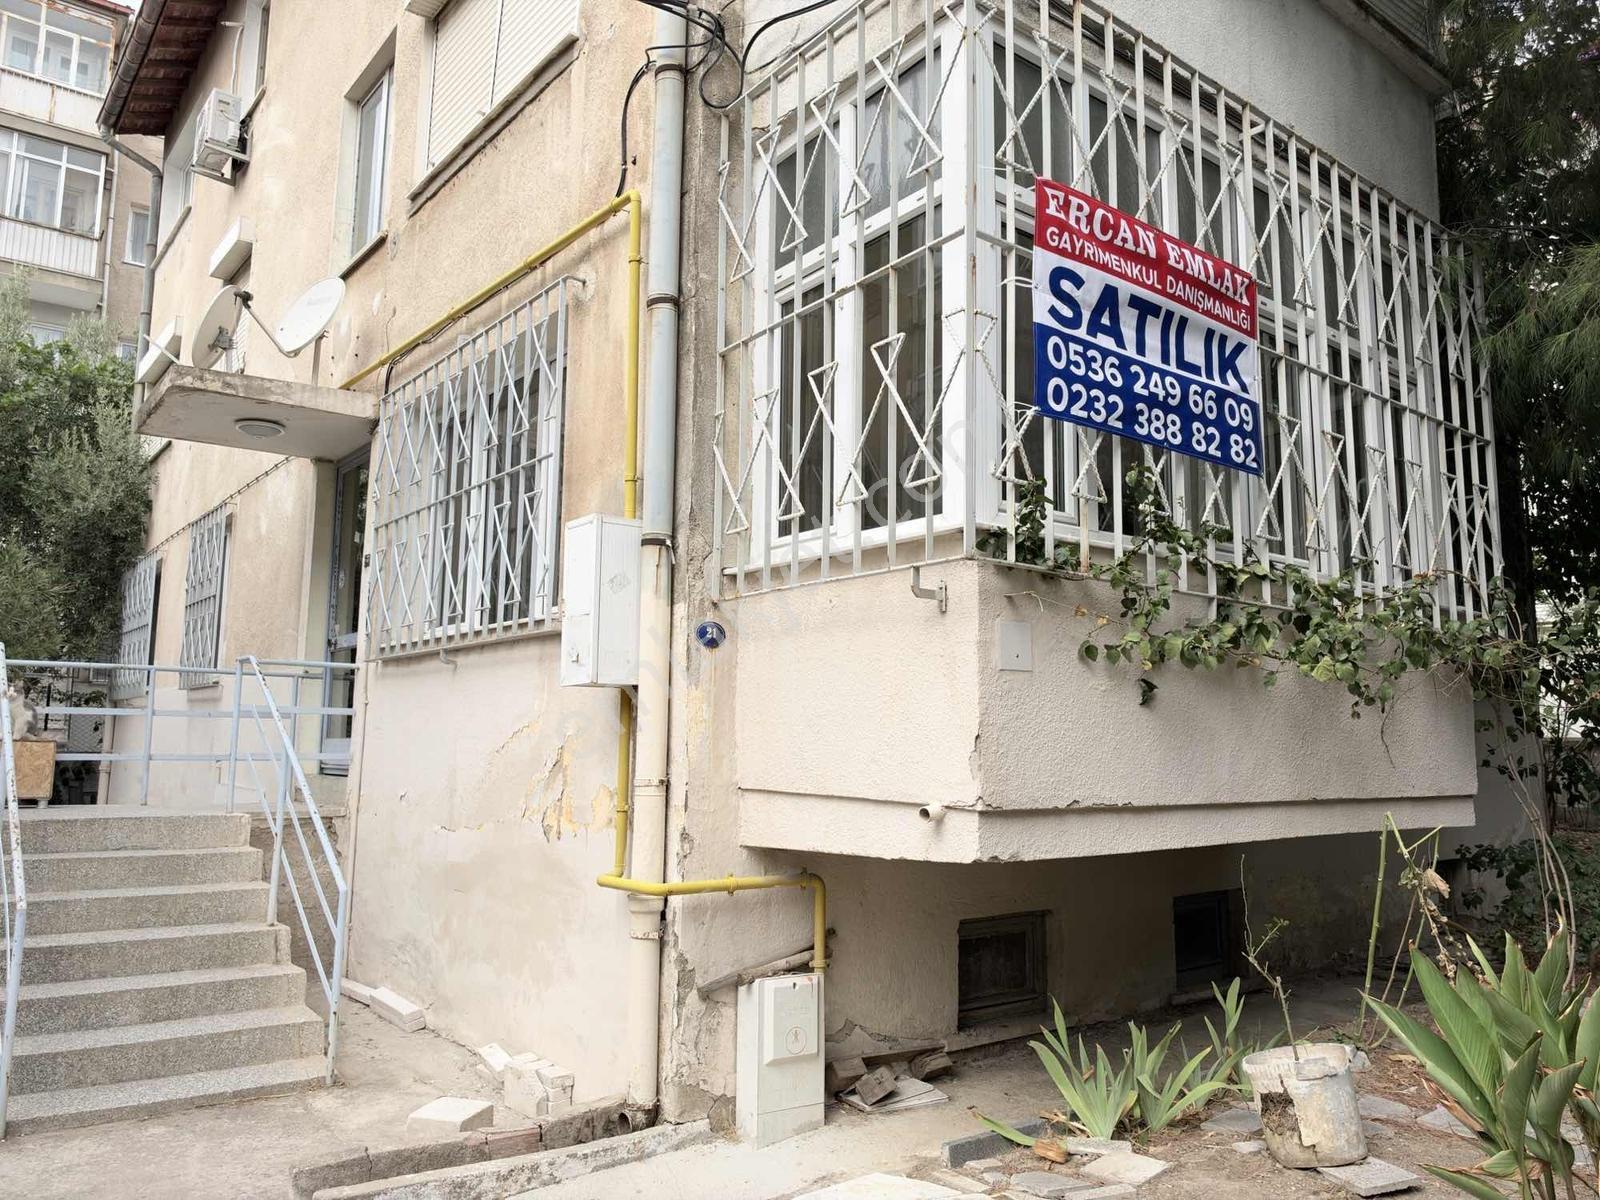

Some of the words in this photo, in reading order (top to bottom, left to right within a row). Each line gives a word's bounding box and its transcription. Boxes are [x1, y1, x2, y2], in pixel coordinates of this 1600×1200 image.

[1045, 186, 1157, 259] ERCAN
[1163, 239, 1251, 307] EMLAK
[1046, 226, 1162, 290] GAYRİMENKUL
[1166, 275, 1251, 332] DANIŞMANLIĞI
[1047, 265, 1251, 397] SATILIK
[1047, 335, 1123, 388] 0536
[1130, 364, 1182, 407] 249
[1188, 384, 1218, 420] 66
[1224, 398, 1254, 432] 09
[1047, 376, 1124, 429] 0232
[1134, 402, 1183, 446] 388
[1191, 424, 1222, 457] 82
[1230, 436, 1258, 468] 82
[706, 626, 717, 639] 21
